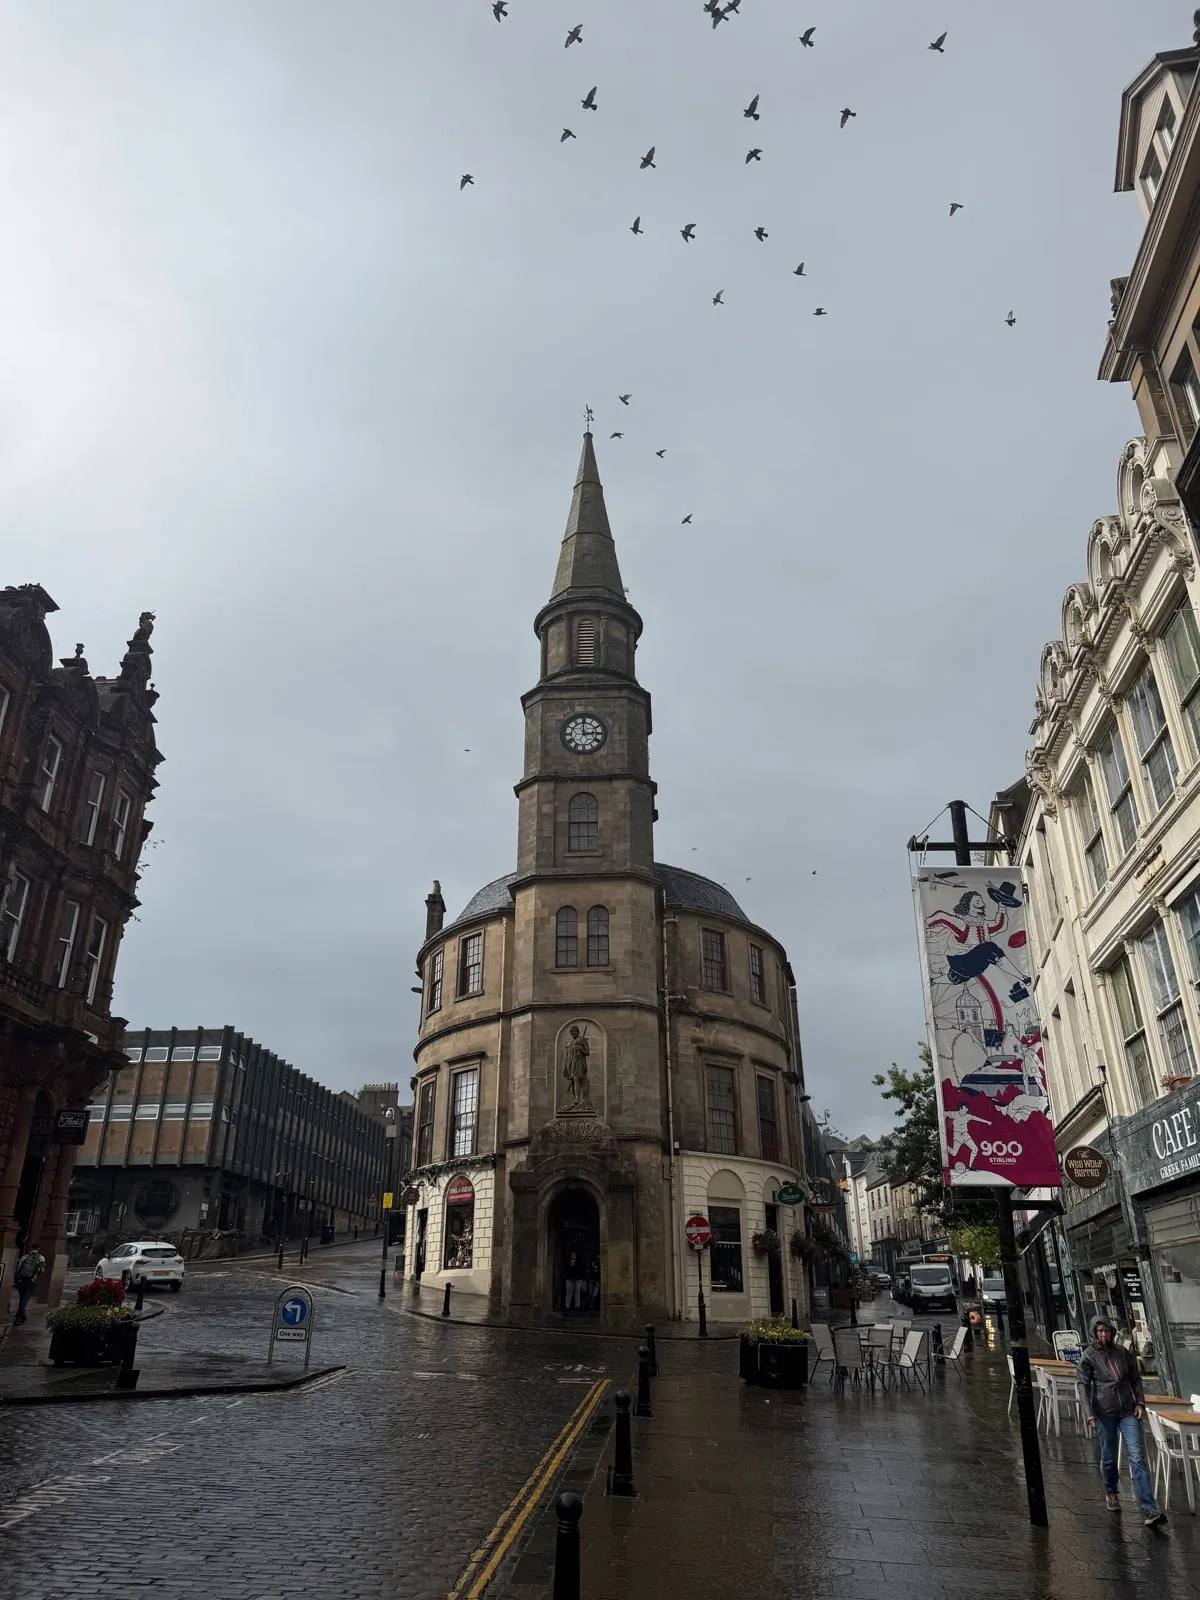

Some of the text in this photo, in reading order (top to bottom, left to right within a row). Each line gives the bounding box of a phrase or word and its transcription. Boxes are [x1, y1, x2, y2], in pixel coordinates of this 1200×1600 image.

[1152, 1107, 1197, 1160] CAFE
[980, 1140, 1023, 1157] 900
[1073, 1168, 1100, 1177] BISTRO
[1160, 1153, 1200, 1179] GREEK FAMIL
